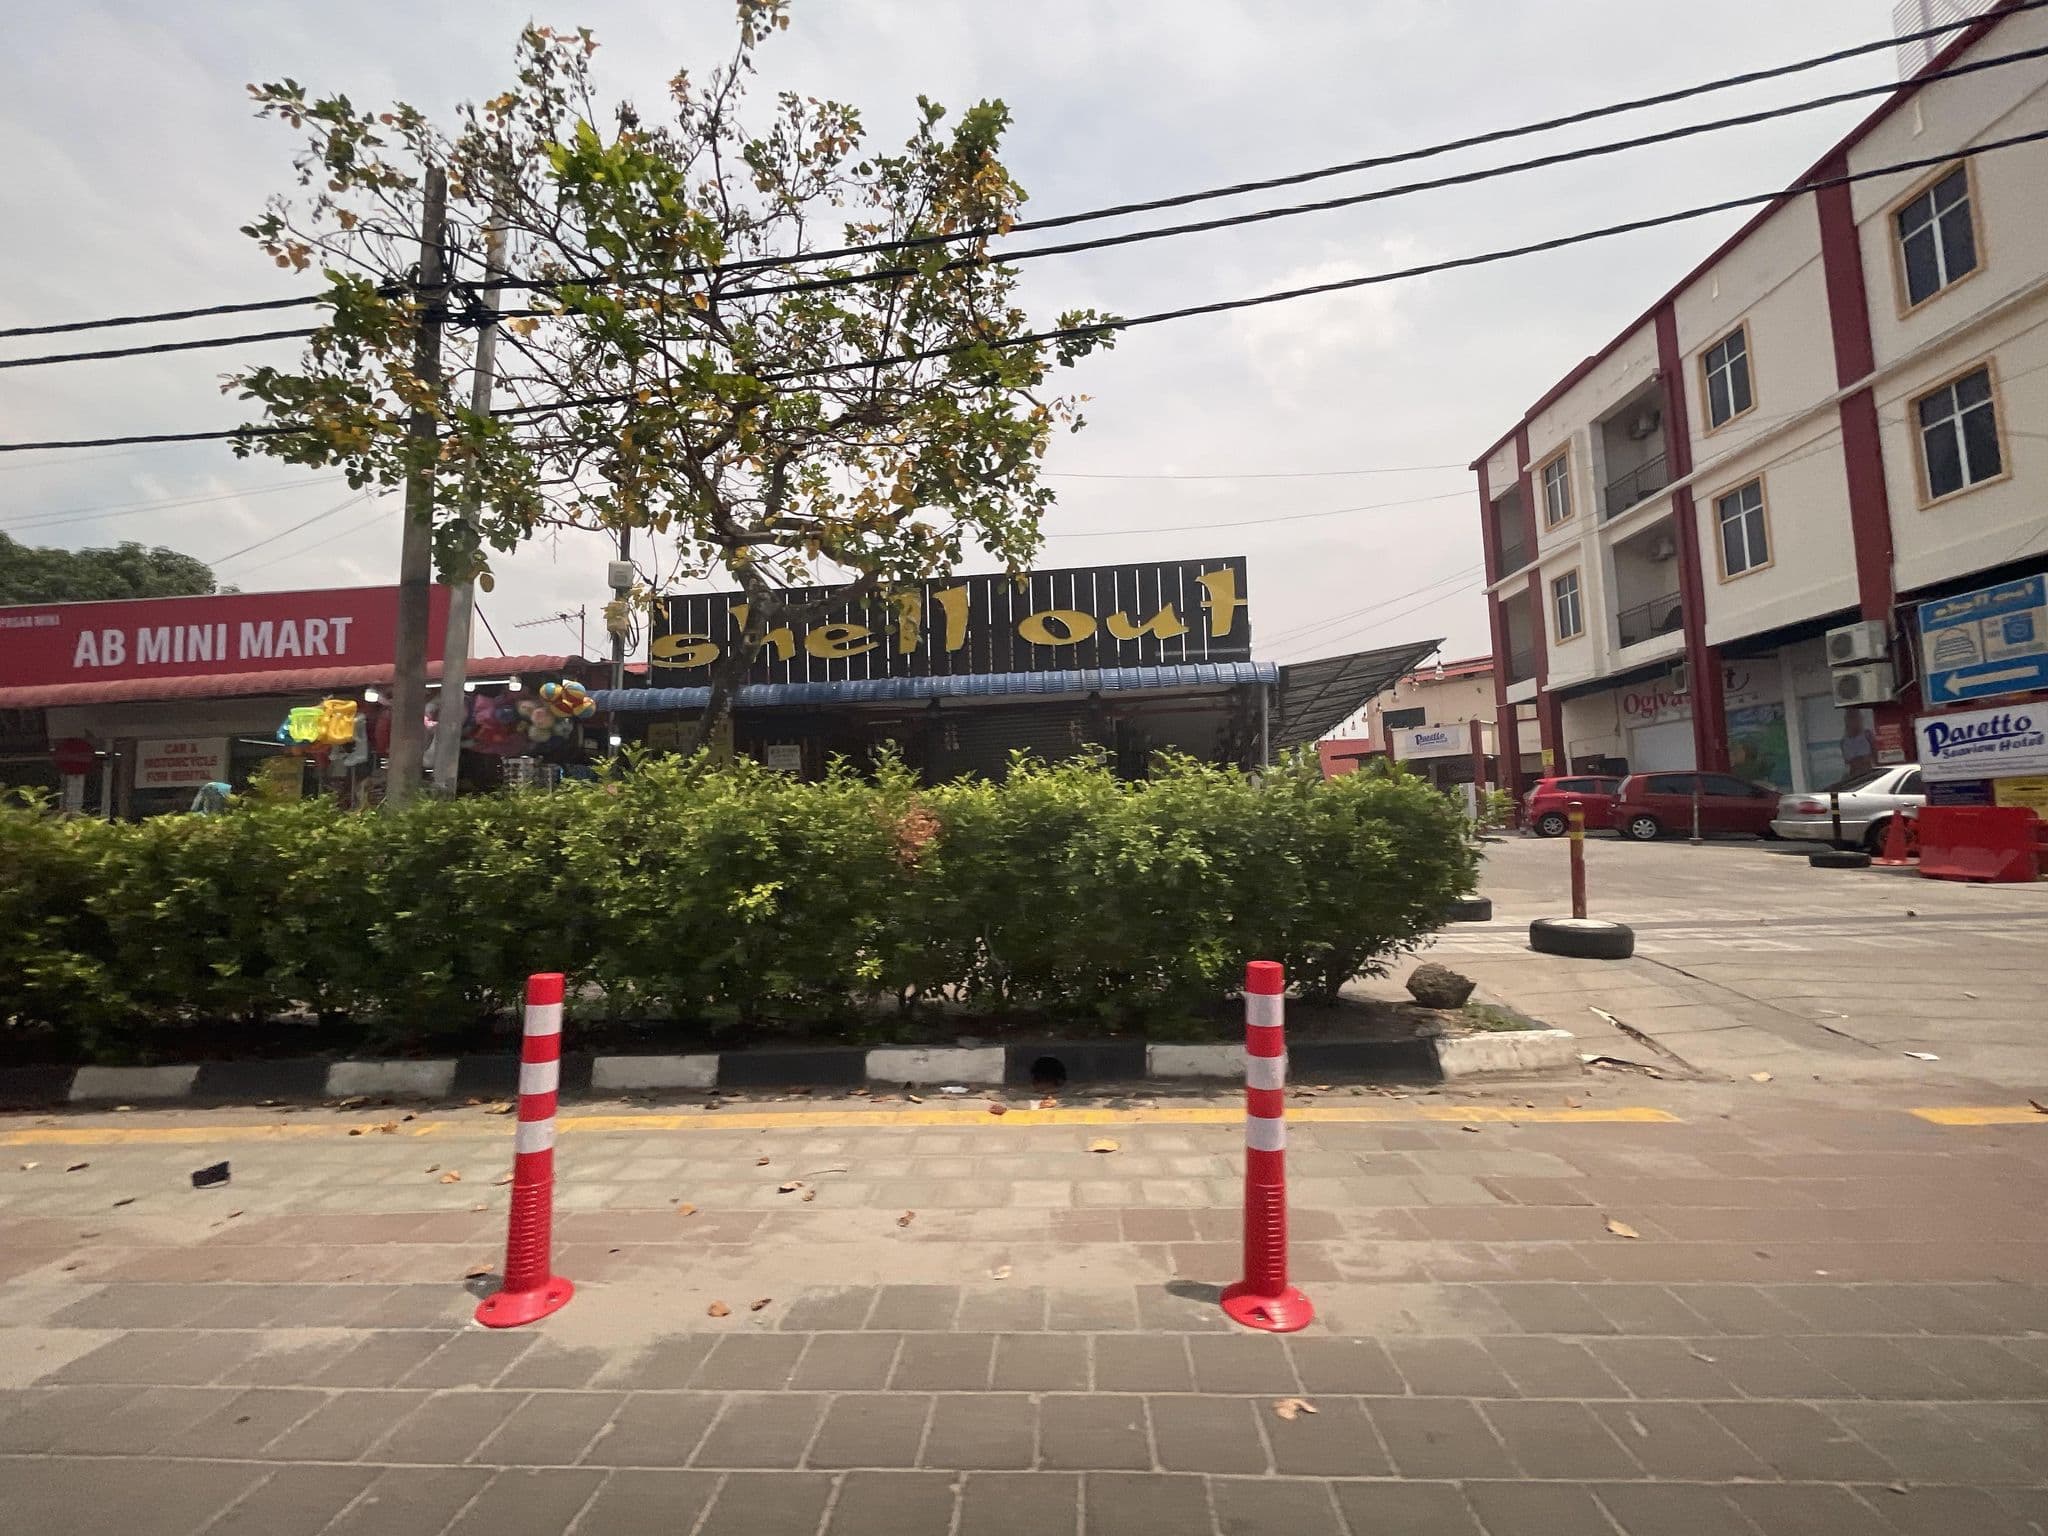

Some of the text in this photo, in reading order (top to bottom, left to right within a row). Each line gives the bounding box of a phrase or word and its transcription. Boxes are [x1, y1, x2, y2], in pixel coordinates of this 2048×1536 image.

[1018, 568, 1247, 646] out
[73, 616, 353, 667] AB MINI MART
[1924, 714, 2032, 757] Paretto
[2000, 734, 2045, 752] Hotel
